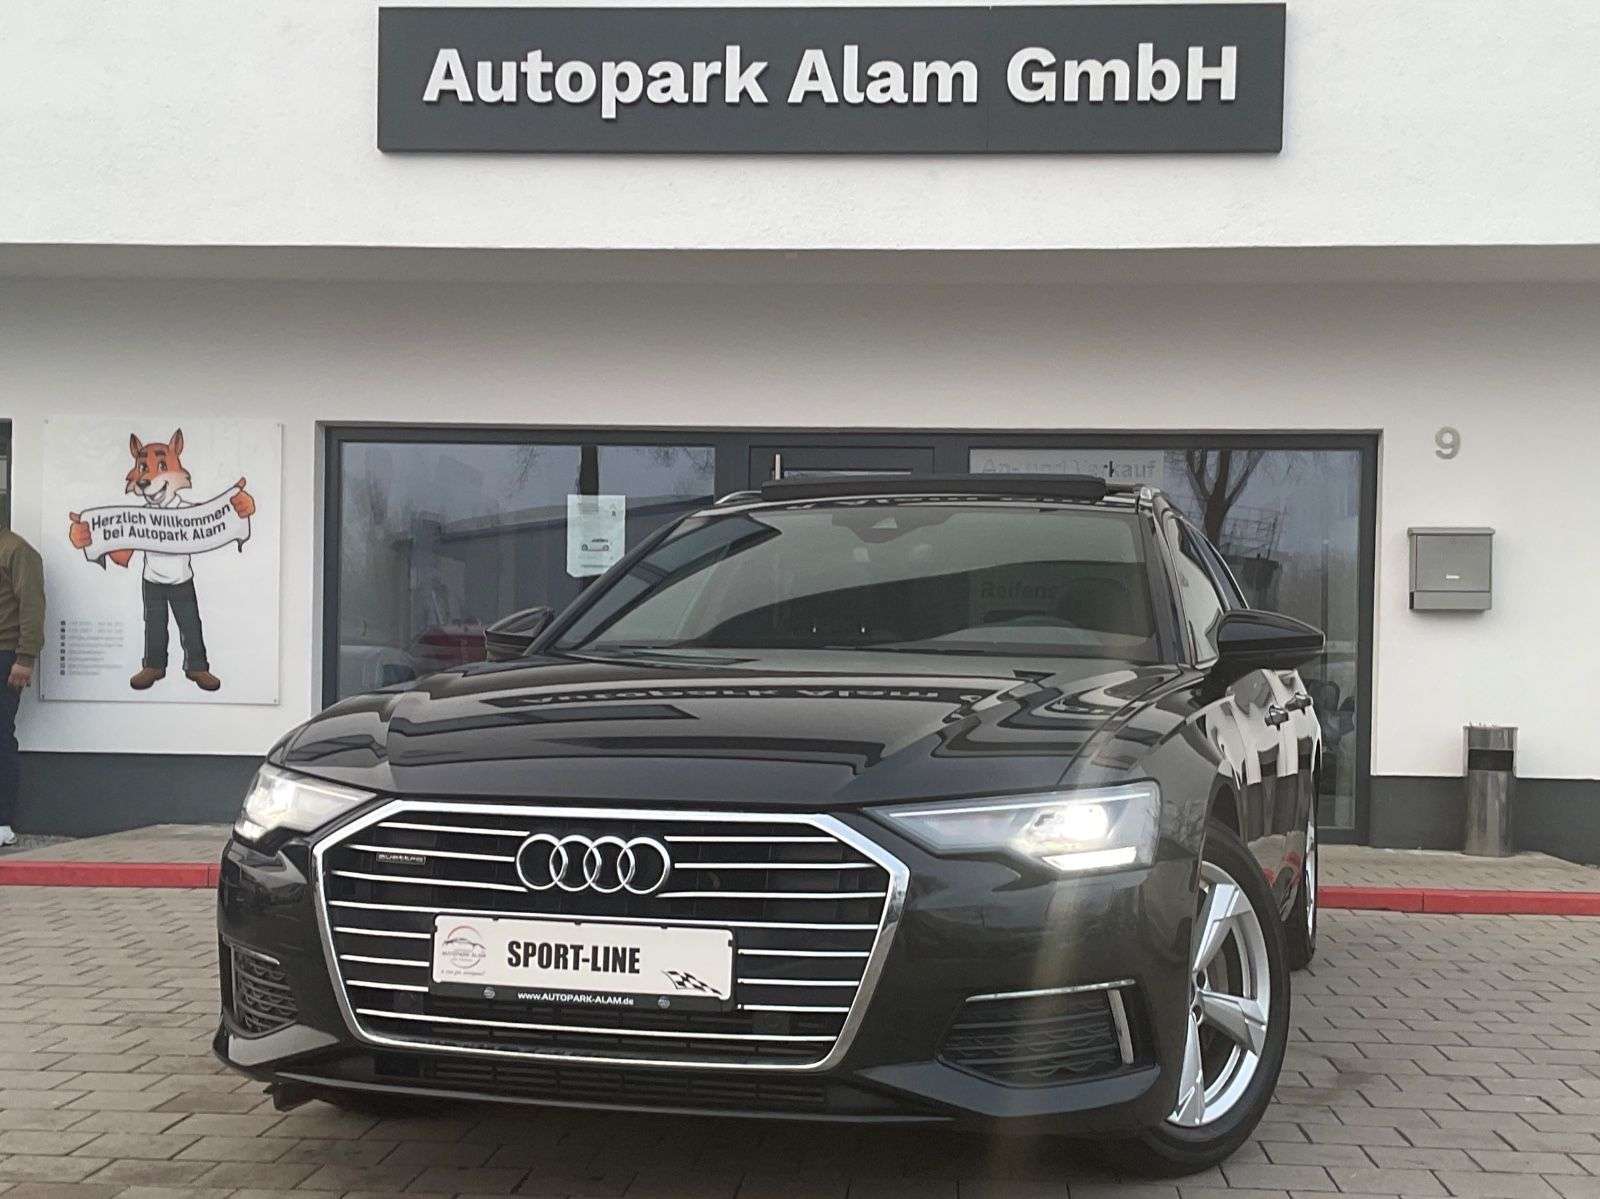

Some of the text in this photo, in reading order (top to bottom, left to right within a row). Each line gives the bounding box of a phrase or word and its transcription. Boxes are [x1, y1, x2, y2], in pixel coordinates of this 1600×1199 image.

[422, 43, 1238, 119] Autopark Alam GmbH
[1435, 426, 1461, 460] 9
[91, 503, 231, 530] Herzlich Willkommen
[103, 522, 226, 543] bei Autopark Alam
[507, 940, 640, 974] SPORT-LINE
[517, 991, 634, 1006] www.AUTOPARK-ALAM.de
